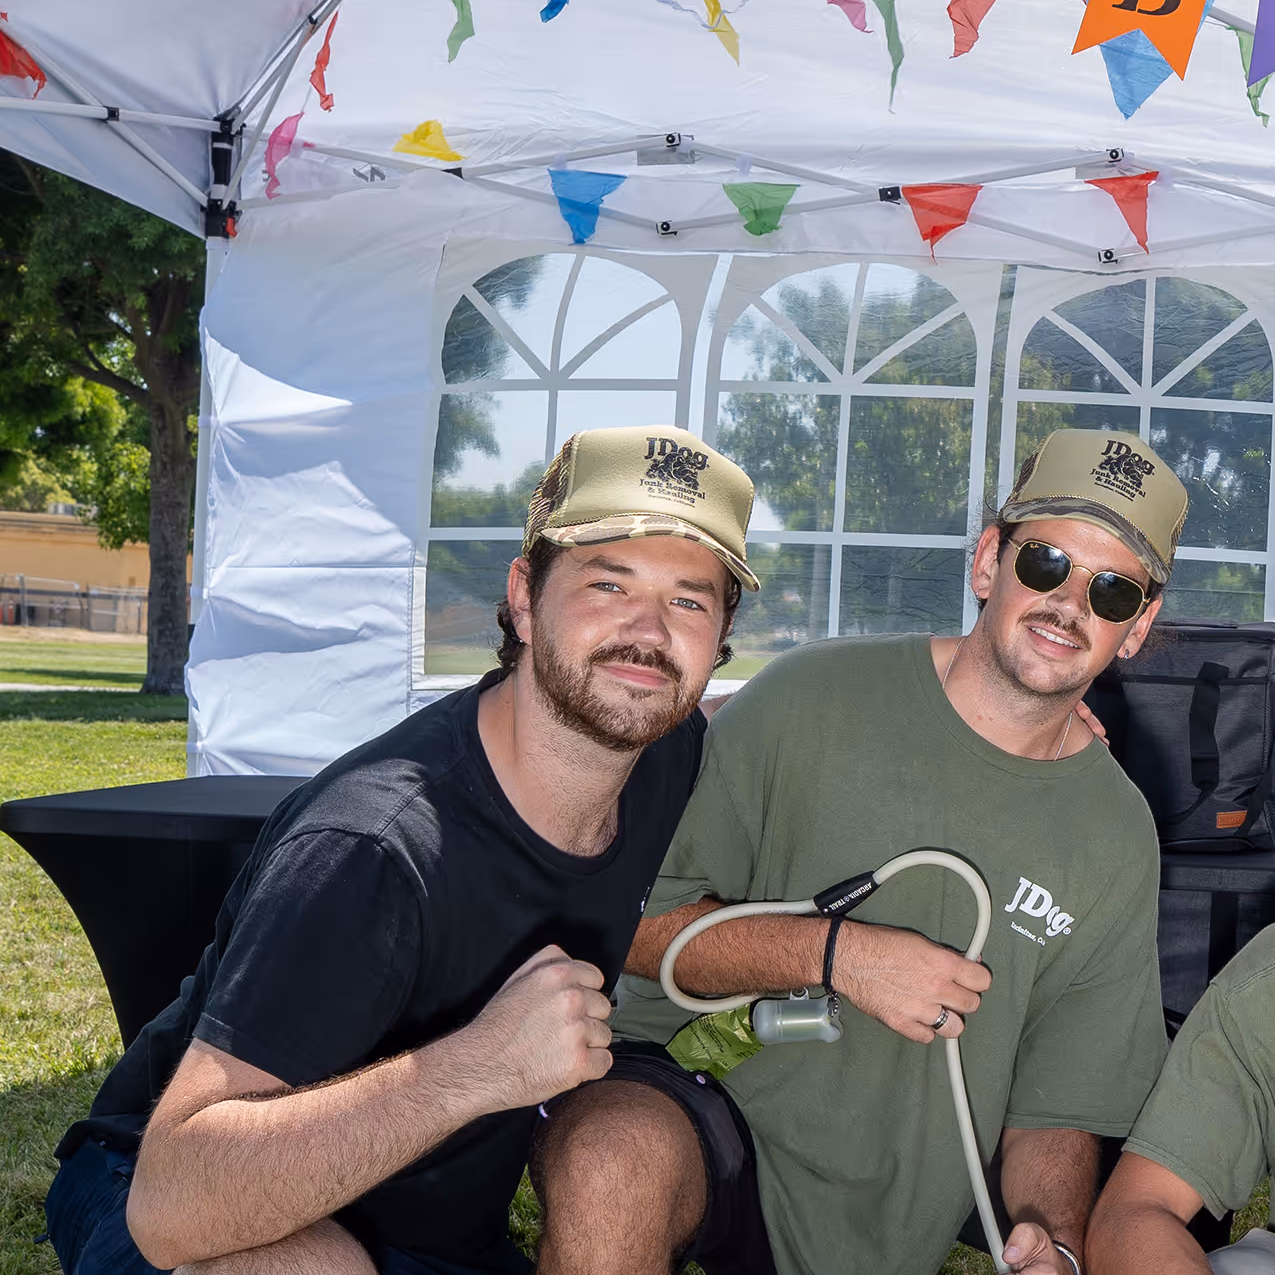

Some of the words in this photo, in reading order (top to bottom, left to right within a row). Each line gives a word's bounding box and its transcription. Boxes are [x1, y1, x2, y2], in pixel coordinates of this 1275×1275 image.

[666, 482, 706, 499] Removal
[1090, 468, 1111, 479] Junk
[1113, 474, 1146, 498] Removal
[1104, 477, 1136, 498] Hauling
[848, 882, 872, 899] ARCADIA
[829, 898, 846, 910] TRAIL
